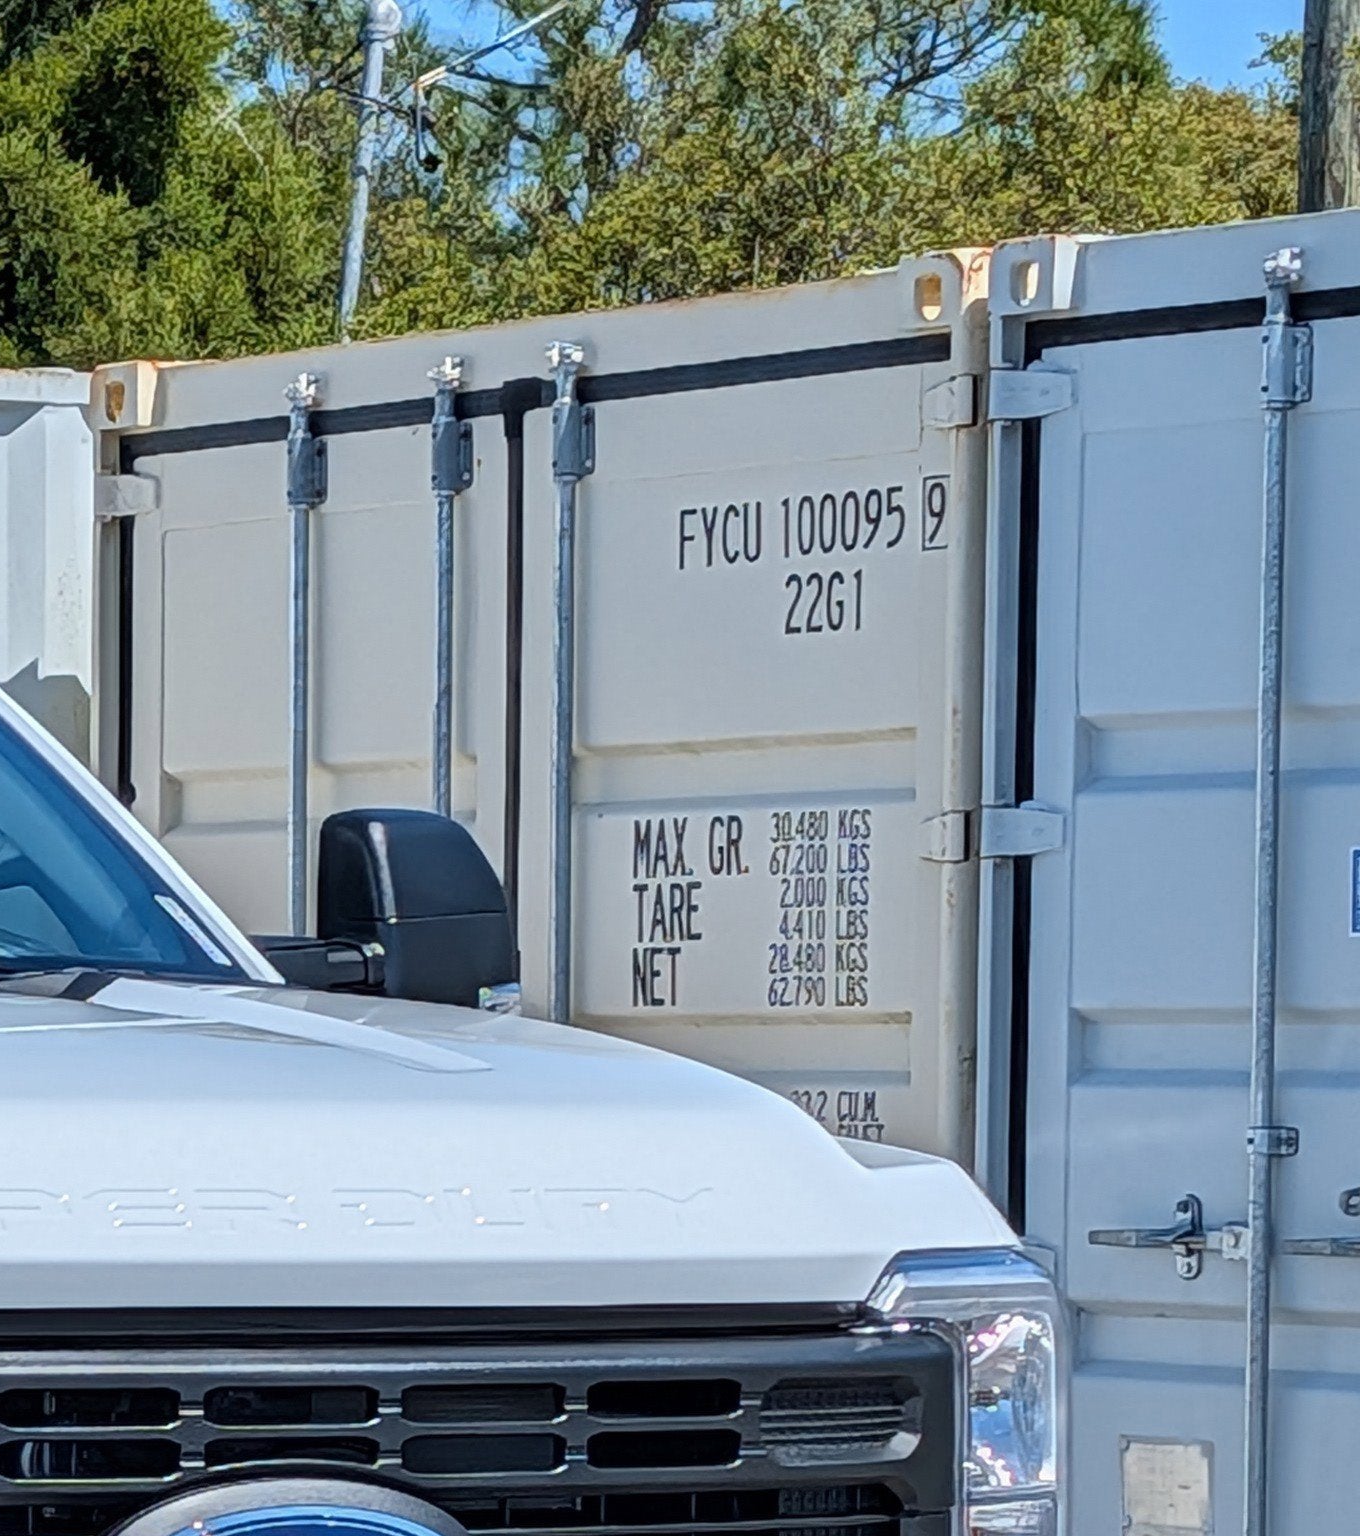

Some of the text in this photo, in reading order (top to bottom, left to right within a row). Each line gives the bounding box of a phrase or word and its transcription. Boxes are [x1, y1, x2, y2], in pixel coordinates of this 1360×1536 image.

[679, 481, 948, 570] FYCU 100095 9
[783, 568, 864, 635] 22G1
[837, 807, 872, 841] KGS
[836, 842, 871, 875] LBS
[632, 881, 703, 944] TARE
[835, 875, 870, 907] KGS
[835, 908, 870, 941] LBS
[632, 947, 682, 1008] NET
[835, 941, 869, 973] KGS
[834, 975, 869, 1008] LBS
[329, 1184, 714, 1232] DUTY
